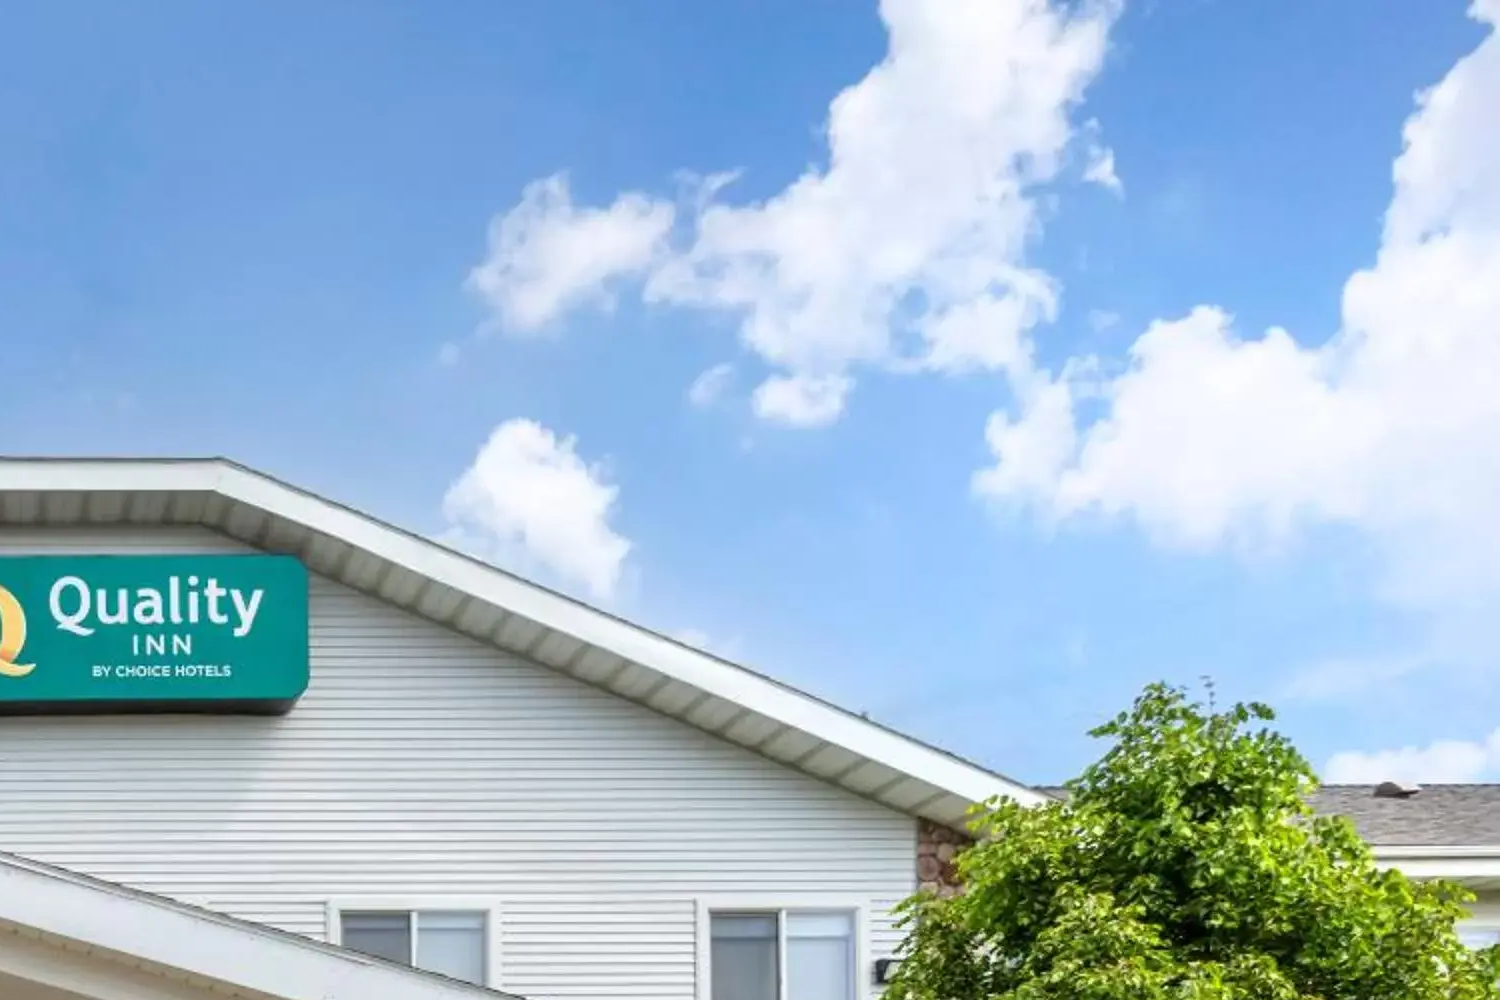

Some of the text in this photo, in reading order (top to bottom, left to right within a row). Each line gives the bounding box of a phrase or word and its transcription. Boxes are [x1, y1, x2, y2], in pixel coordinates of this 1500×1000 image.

[49, 575, 264, 636] Quality
[132, 633, 192, 656] INN
[91, 664, 232, 678] BY CHOICE HOTELS
